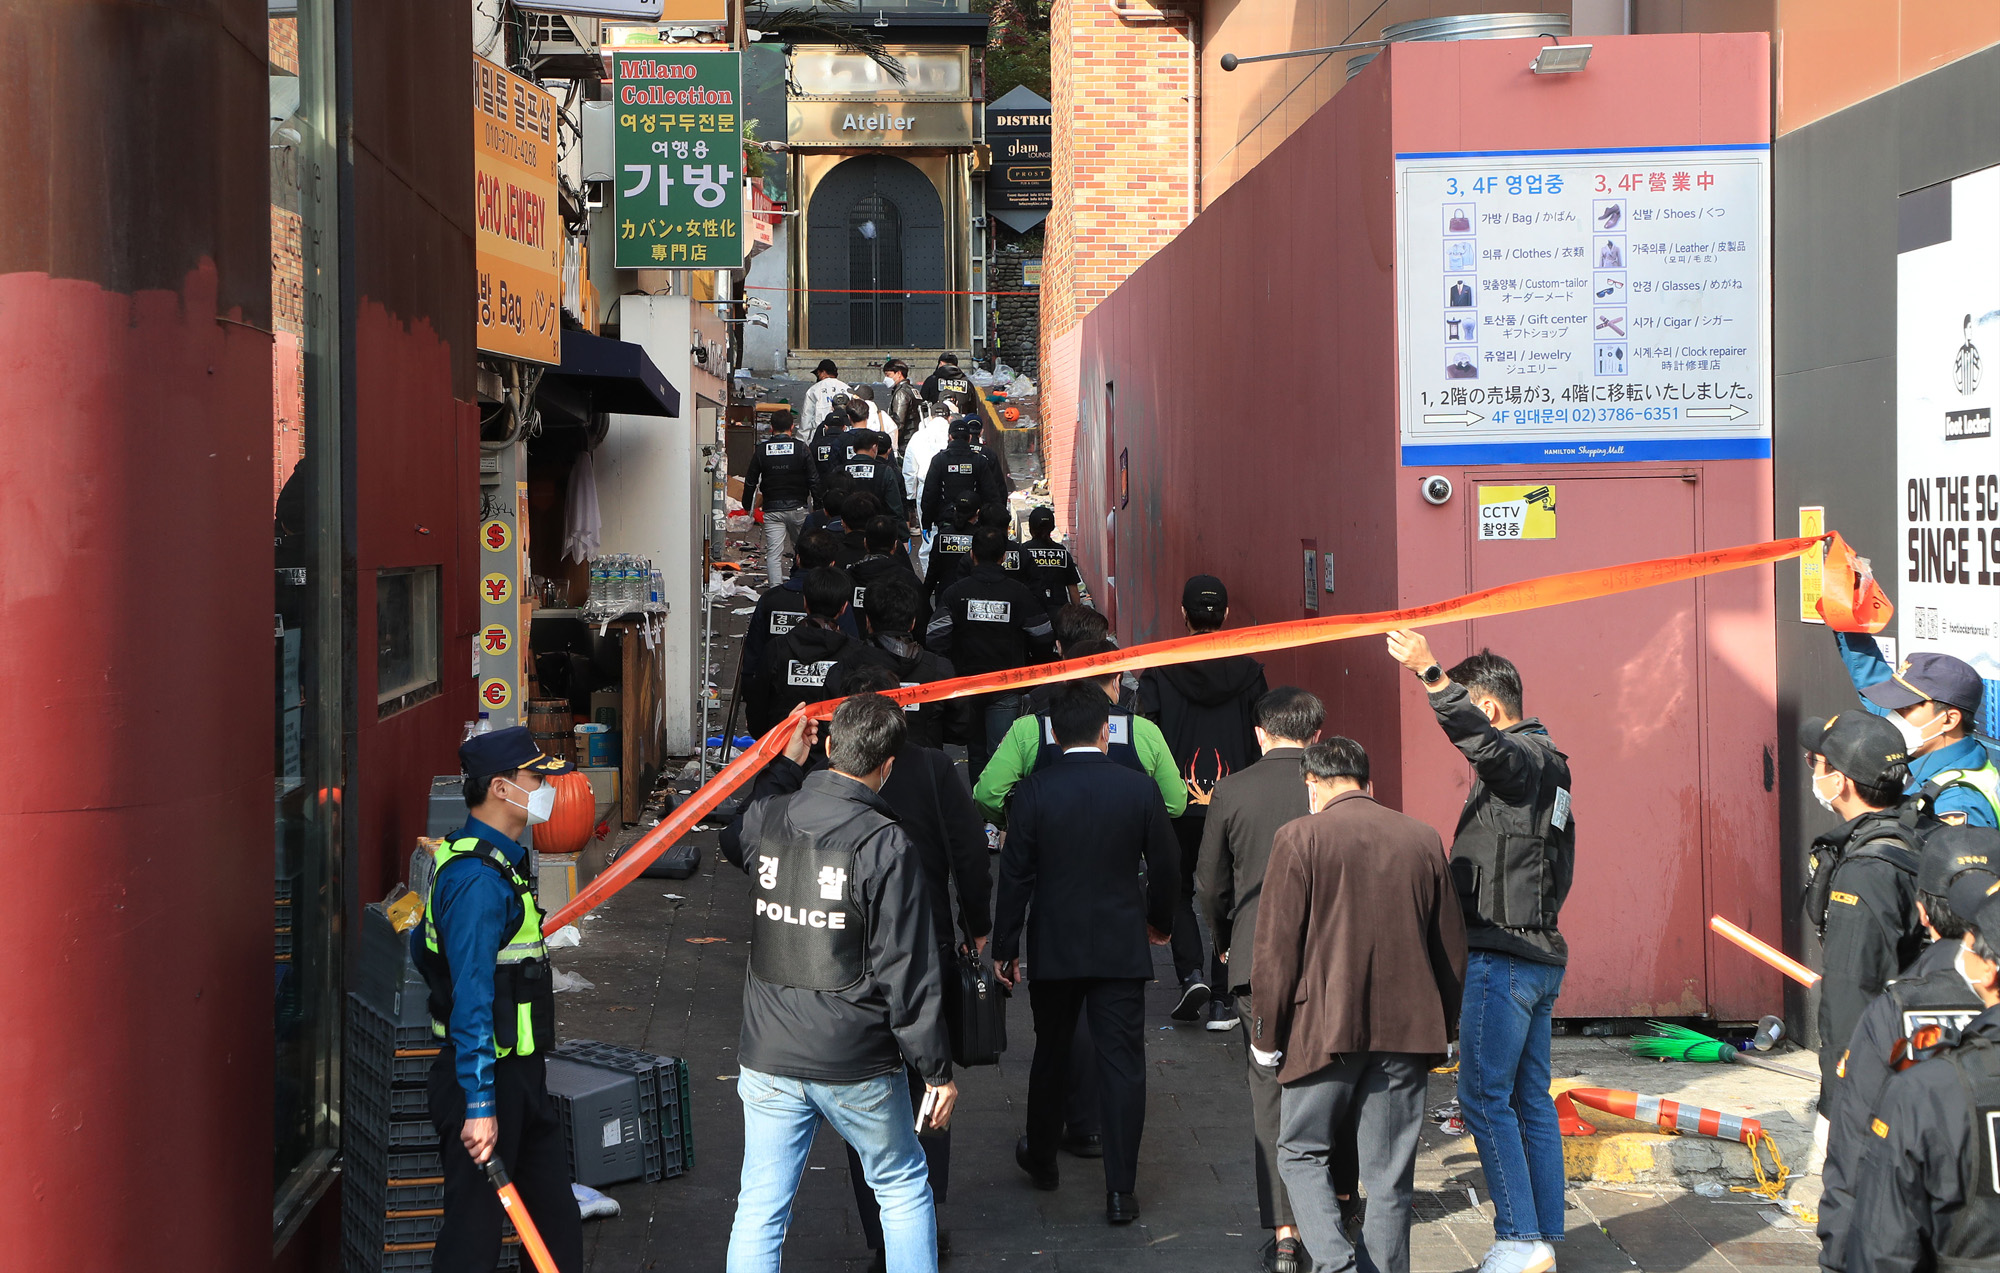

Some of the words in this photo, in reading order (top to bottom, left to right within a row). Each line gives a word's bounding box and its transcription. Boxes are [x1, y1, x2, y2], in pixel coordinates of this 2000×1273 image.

[619, 60, 697, 79] Milano
[621, 84, 733, 104] Collection
[620, 113, 735, 133] 여성구두전문
[842, 112, 915, 131] Atelier
[651, 140, 709, 159] 여행용
[1008, 139, 1039, 157] glam
[623, 164, 733, 208] 가방
[1447, 177, 1465, 197] 3,
[1472, 176, 1498, 194] 4F
[1505, 174, 1564, 195] 영업중
[1594, 174, 1612, 194] 3,
[1618, 173, 1643, 192] 4F
[1649, 171, 1714, 192] 營業中
[477, 169, 502, 236] CHO
[503, 182, 546, 250] JEWERY
[1632, 209, 1653, 221] 신발
[1663, 208, 1696, 220] Shoes
[1706, 207, 1726, 218] くつ
[1482, 213, 1501, 225] 가방
[1512, 213, 1532, 226] Bag
[1542, 211, 1577, 223] かばん
[621, 217, 737, 240] カバン・女性化
[651, 243, 708, 261] 專門店
[1482, 249, 1503, 260] 의류
[1512, 248, 1552, 260] Clothes
[1562, 246, 1585, 258] 衣類
[1632, 243, 1667, 255] 가죽의류
[1675, 242, 1709, 254] Leather
[1718, 241, 1746, 252] 皮製品
[1482, 279, 1518, 290] 맞춤양복
[1525, 277, 1588, 289] Custom-tailor
[1632, 281, 1652, 293] 안경
[1662, 280, 1700, 291] Glasses
[1710, 278, 1743, 290] めがね
[1502, 292, 1574, 304] オーダーメード
[500, 279, 526, 336] Bag,
[1483, 314, 1517, 326] 토산품
[1528, 314, 1548, 325] Gift
[1550, 314, 1588, 324] center
[1632, 316, 1654, 328] 시가
[1663, 316, 1692, 328] Cigar
[1702, 314, 1734, 326] シガー
[1502, 326, 1569, 340] ギフトショップ
[1484, 350, 1517, 362] 쥬얼리
[1528, 350, 1572, 362] Jewelry
[1681, 346, 1707, 357] Clock
[1709, 346, 1747, 358] repairer
[1506, 364, 1558, 375] ジュエリー
[1661, 360, 1721, 371] 時計修理店
[1492, 410, 1510, 424] 4F
[1514, 408, 1568, 424] 임대문의
[1572, 407, 1678, 423] 02)3786-6351
[1946, 416, 1962, 436] Foot
[1964, 413, 1991, 434] Locker
[1578, 446, 1607, 458] Shopping
[1607, 446, 1624, 454] Mall
[1908, 478, 1931, 522] ON
[1936, 475, 1970, 522] THE
[1482, 506, 1520, 518] CCTV
[1482, 522, 1520, 537] 촬영중
[942, 536, 971, 544] 과학수
[1908, 528, 1970, 585] SINCE
[485, 629, 506, 651] 元
[1830, 890, 1859, 906] KCSI
[756, 898, 846, 930] POLICE
